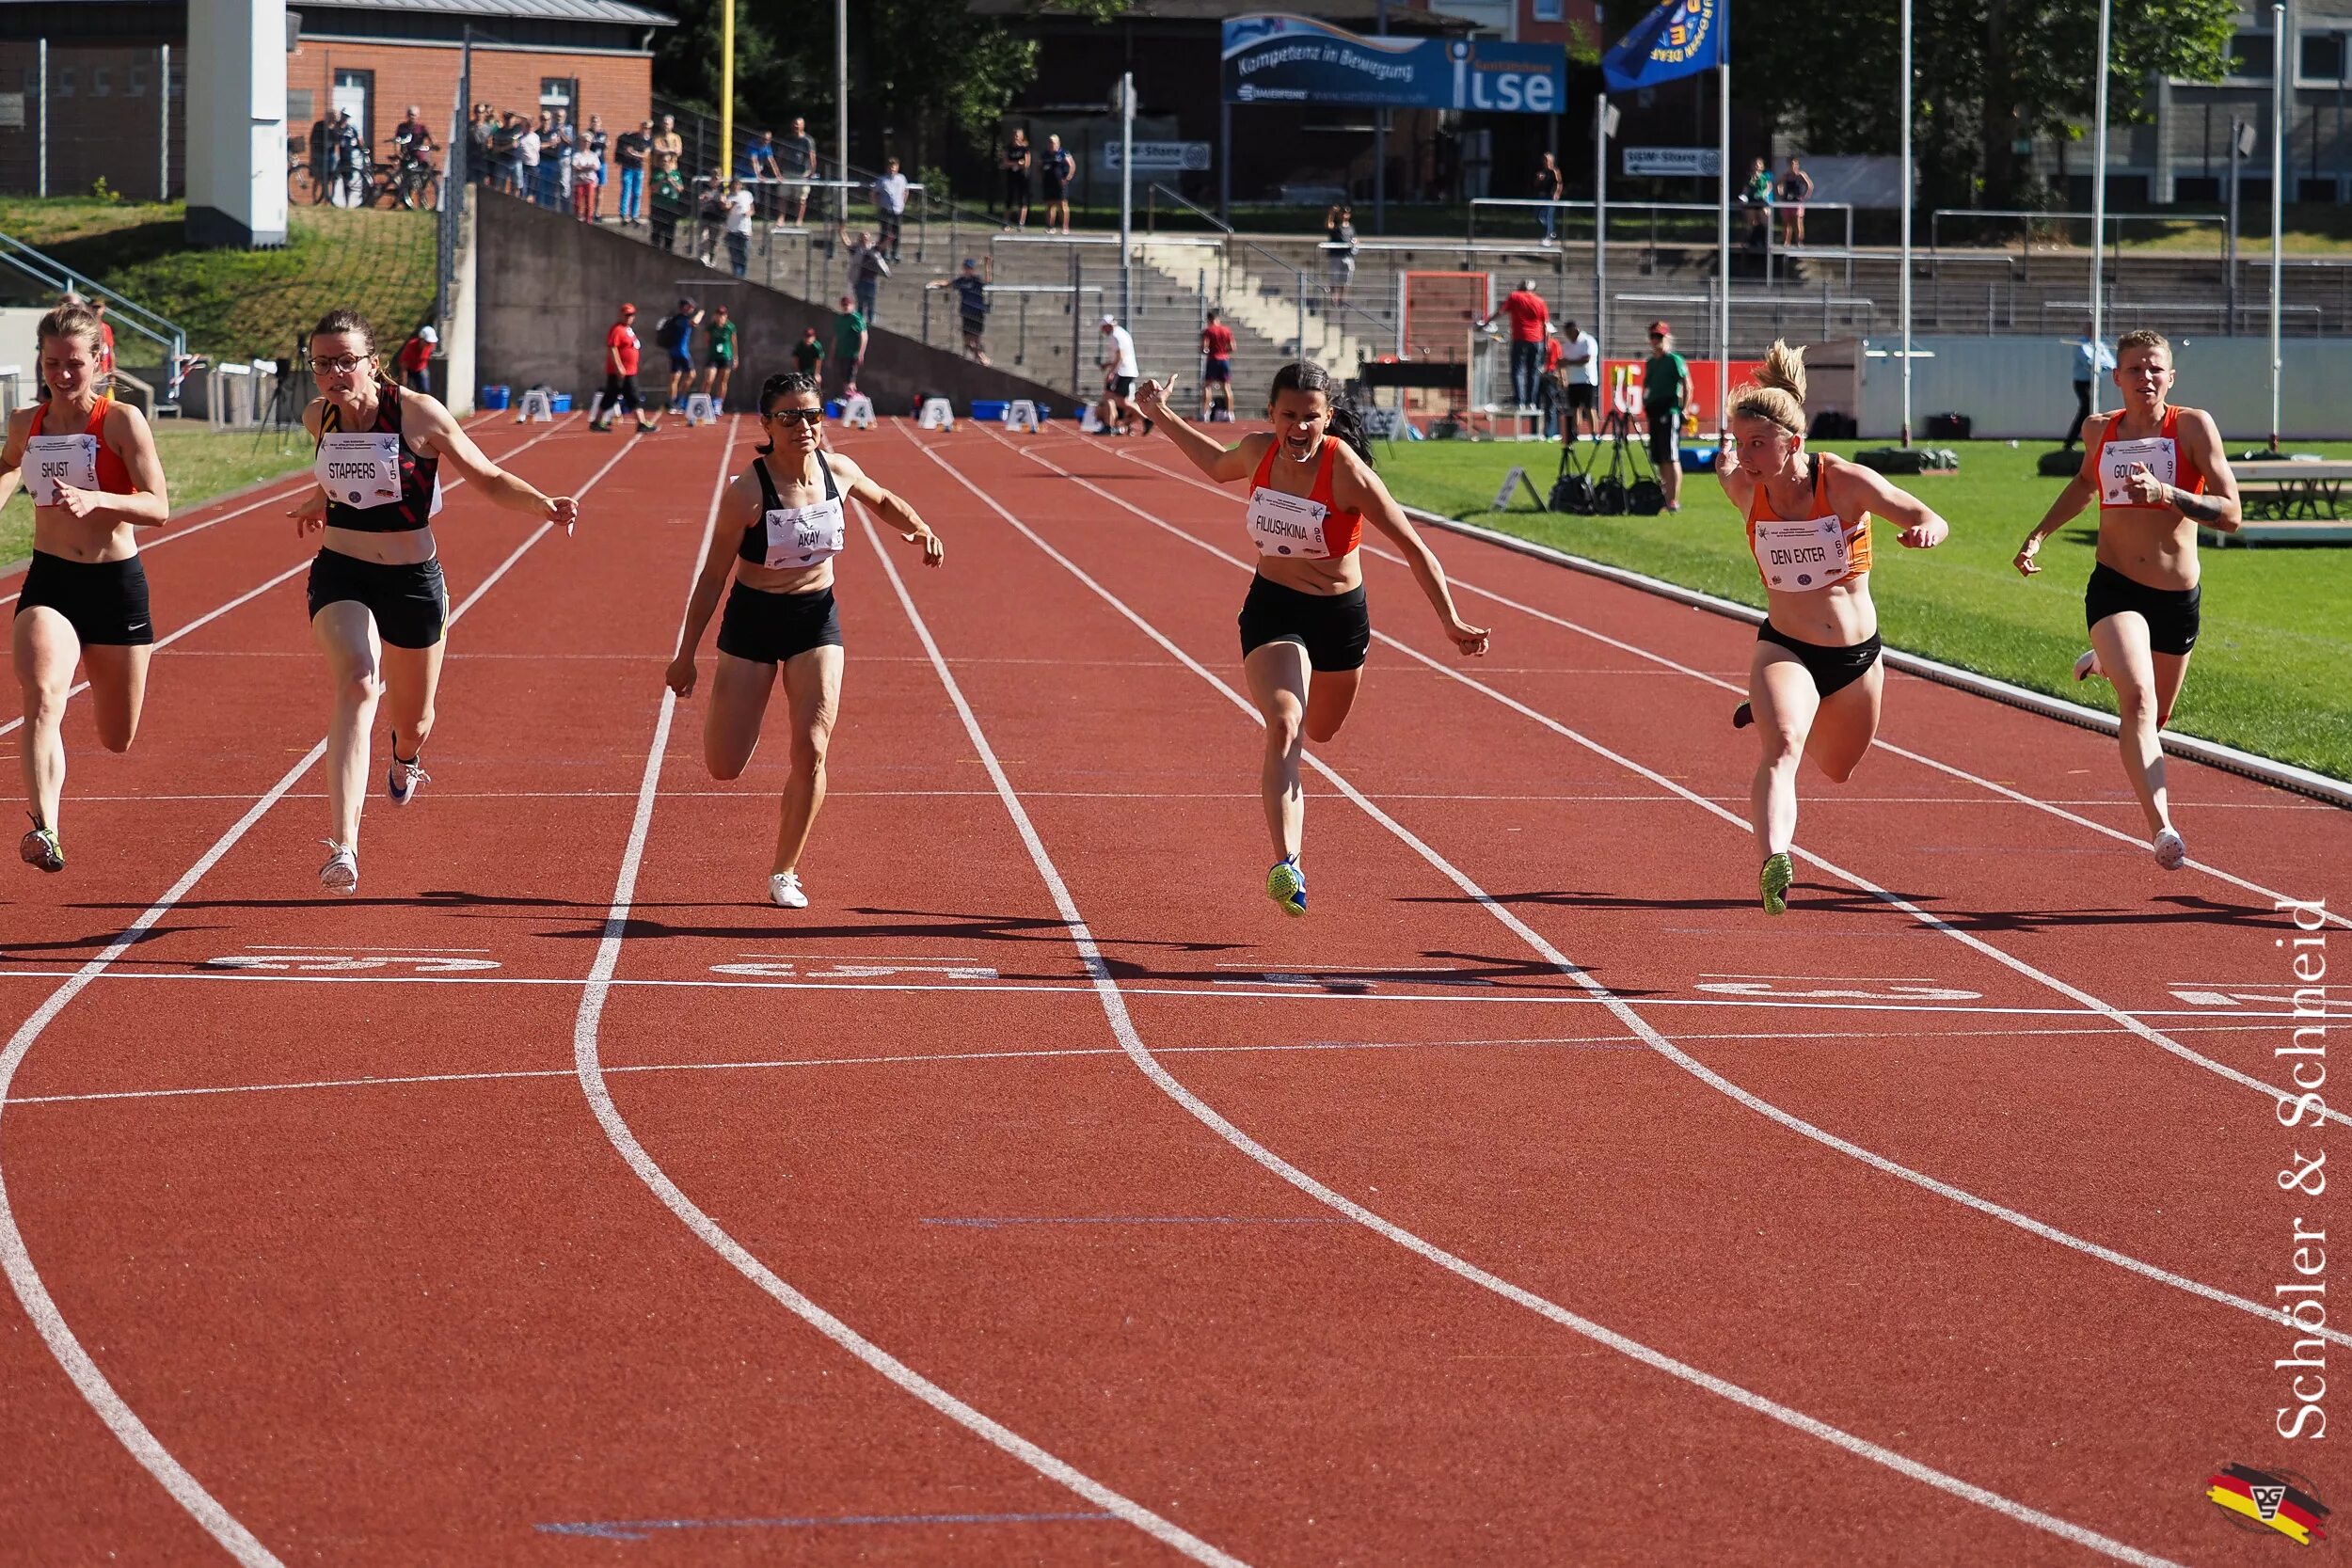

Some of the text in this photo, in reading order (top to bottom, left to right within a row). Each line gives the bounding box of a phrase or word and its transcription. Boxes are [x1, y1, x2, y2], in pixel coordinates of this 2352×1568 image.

[1650, 0, 1713, 62] UROPEAN DEAF
[1237, 46, 1320, 77] Kompetenz
[1340, 49, 1414, 83] Bewegung
[692, 402, 705, 418] 6
[41, 461, 70, 478] SHUST
[328, 462, 376, 480] STAPPERS
[389, 459, 397, 481] 15
[2167, 460, 2174, 480] 97
[1256, 515, 1309, 541] FILIUSHKINA
[1313, 527, 1323, 544] 96
[798, 530, 821, 548] AKAY
[1835, 539, 1844, 558] 69
[1770, 546, 1826, 565] DEN EXTER
